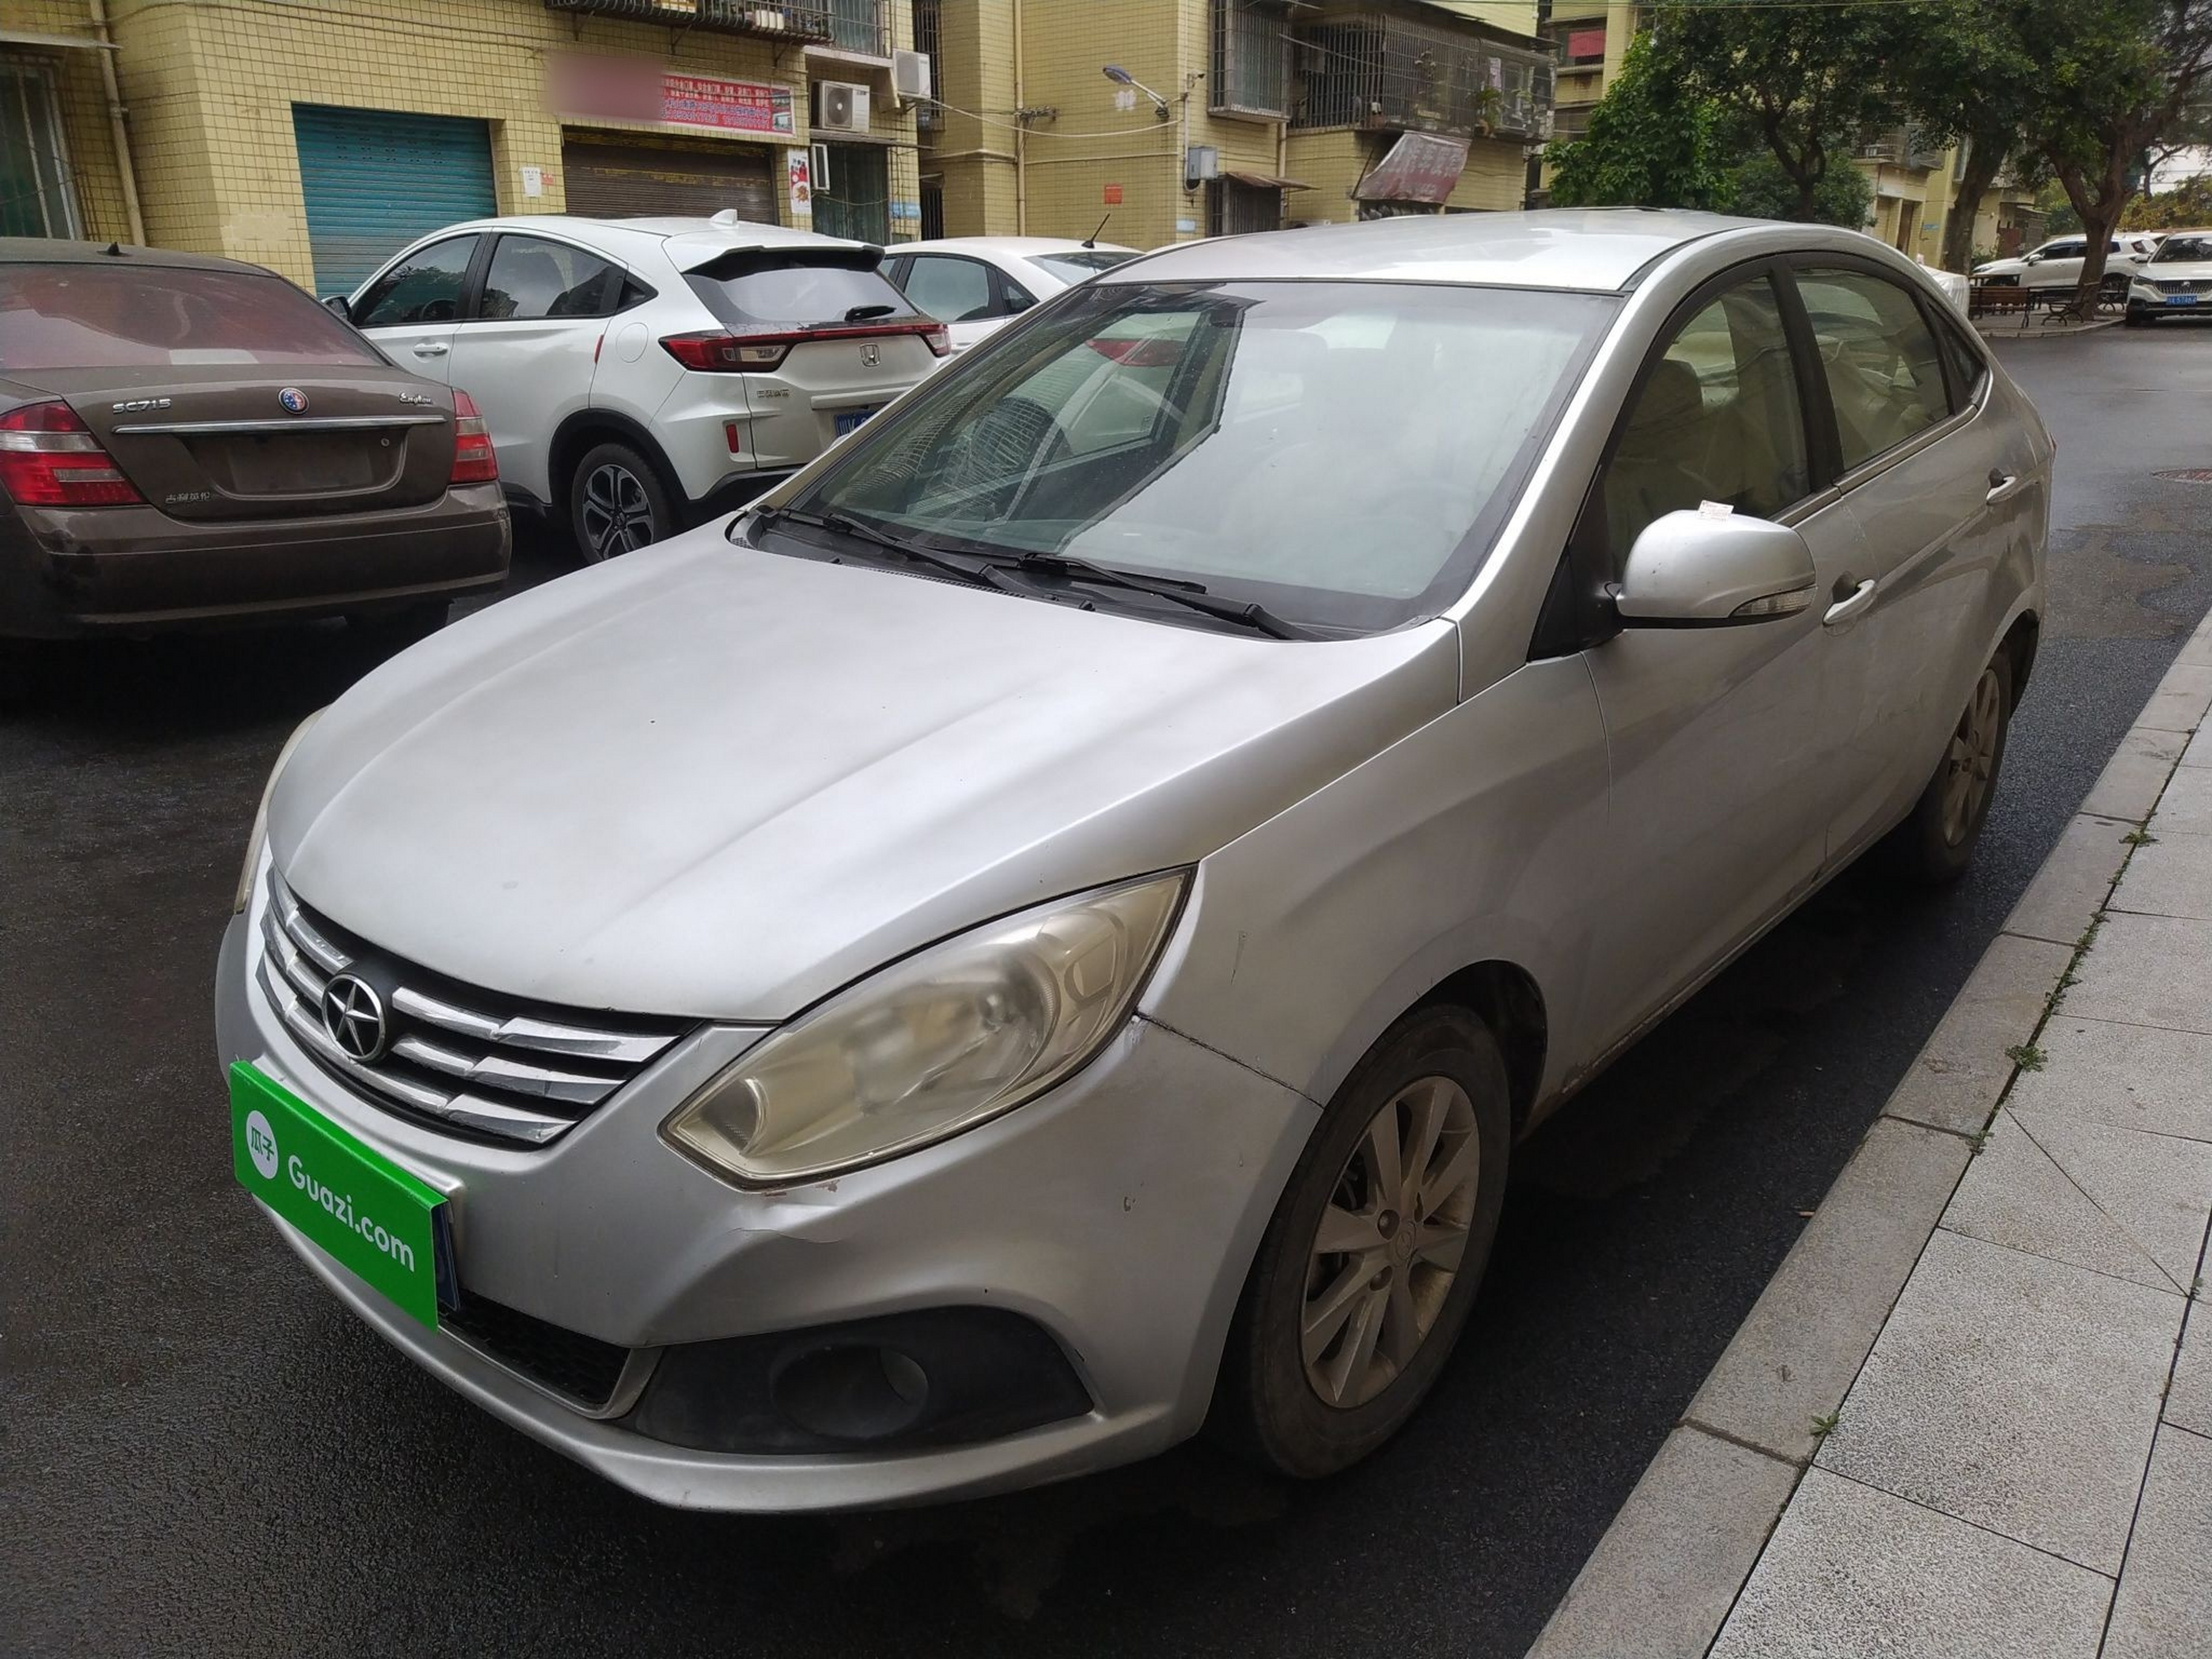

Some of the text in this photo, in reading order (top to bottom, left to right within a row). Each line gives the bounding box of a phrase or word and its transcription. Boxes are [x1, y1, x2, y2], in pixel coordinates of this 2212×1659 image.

[112, 398, 172, 414] SC715
[251, 1126, 274, 1161] 瓜子
[288, 1154, 415, 1272] Guazi.com
